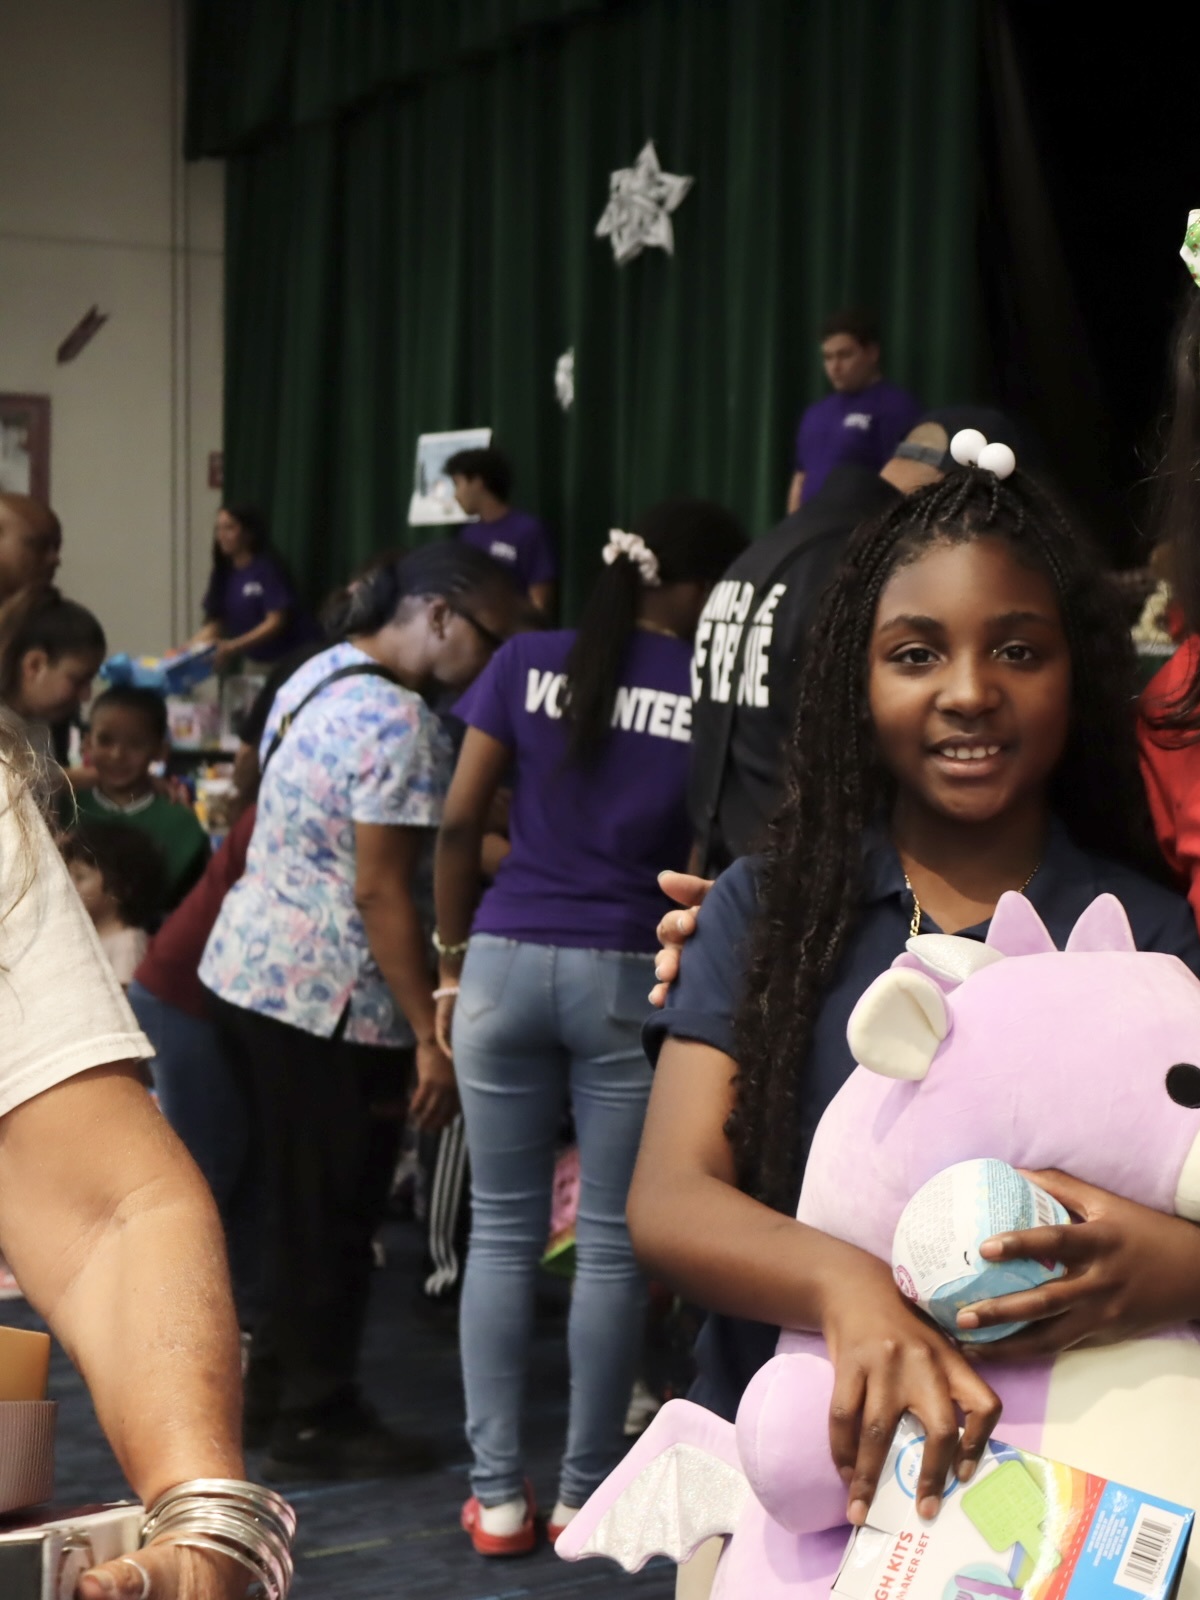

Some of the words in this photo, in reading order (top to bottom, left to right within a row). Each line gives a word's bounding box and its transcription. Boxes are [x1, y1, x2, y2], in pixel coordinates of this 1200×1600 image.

[524, 667, 693, 743] VONTEE
[886, 1530, 915, 1574] KITS
[895, 1558, 921, 1600] MAKER
[915, 1532, 931, 1556] SET
